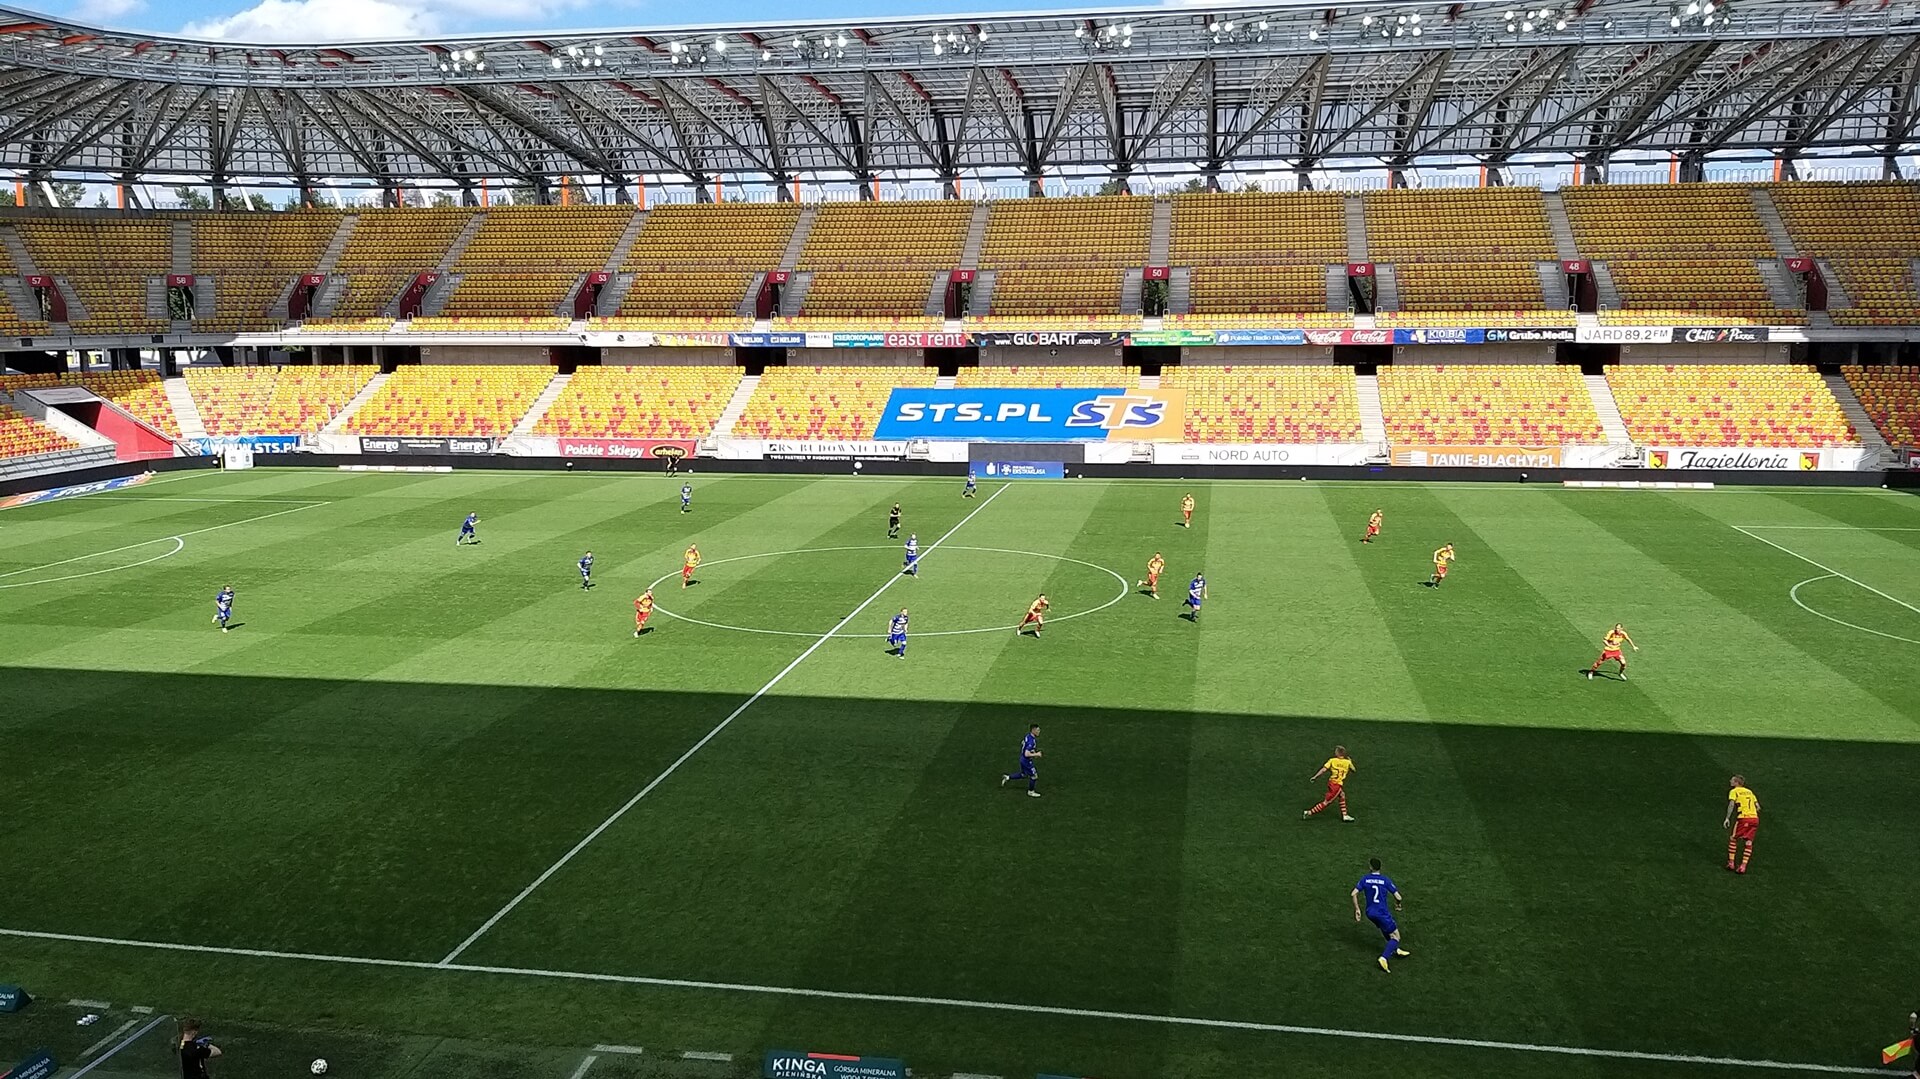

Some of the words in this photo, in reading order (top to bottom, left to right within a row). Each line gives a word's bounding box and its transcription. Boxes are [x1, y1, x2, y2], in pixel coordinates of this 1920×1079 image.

[1568, 262, 1580, 271] 48
[1791, 260, 1802, 269] 47
[1152, 269, 1162, 277] 50
[1355, 265, 1366, 274] 49
[310, 276, 320, 284] 55
[426, 275, 436, 283] 54
[598, 274, 607, 282] 53
[776, 273, 785, 281] 52
[960, 272, 969, 280] 51
[31, 277, 42, 285] 57
[888, 333, 922, 346] east
[927, 333, 962, 346] rent
[1583, 329, 1622, 341] JARD
[1624, 329, 1652, 341] 89.2
[1653, 329, 1668, 338] FM
[724, 348, 733, 357] 20
[787, 349, 797, 357] 20
[1325, 346, 1333, 355] 17
[1396, 346, 1405, 354] 17
[896, 402, 1052, 423] STS.PL
[1065, 395, 1168, 429] STS
[362, 438, 400, 453] Energo
[450, 439, 488, 453] Energo
[564, 444, 604, 456] Polskie
[607, 444, 645, 459] Sklepy
[1208, 450, 1249, 462] NORD
[1252, 450, 1290, 462] AUTO
[1430, 453, 1557, 468] TANIE-BLACHY.PL
[1680, 451, 1789, 470] Jagiellonia
[1371, 885, 1380, 903] 2
[772, 1058, 827, 1075] KINGA
[833, 1065, 860, 1074] GÓRSKA
[860, 1067, 897, 1077] MINERALNA
